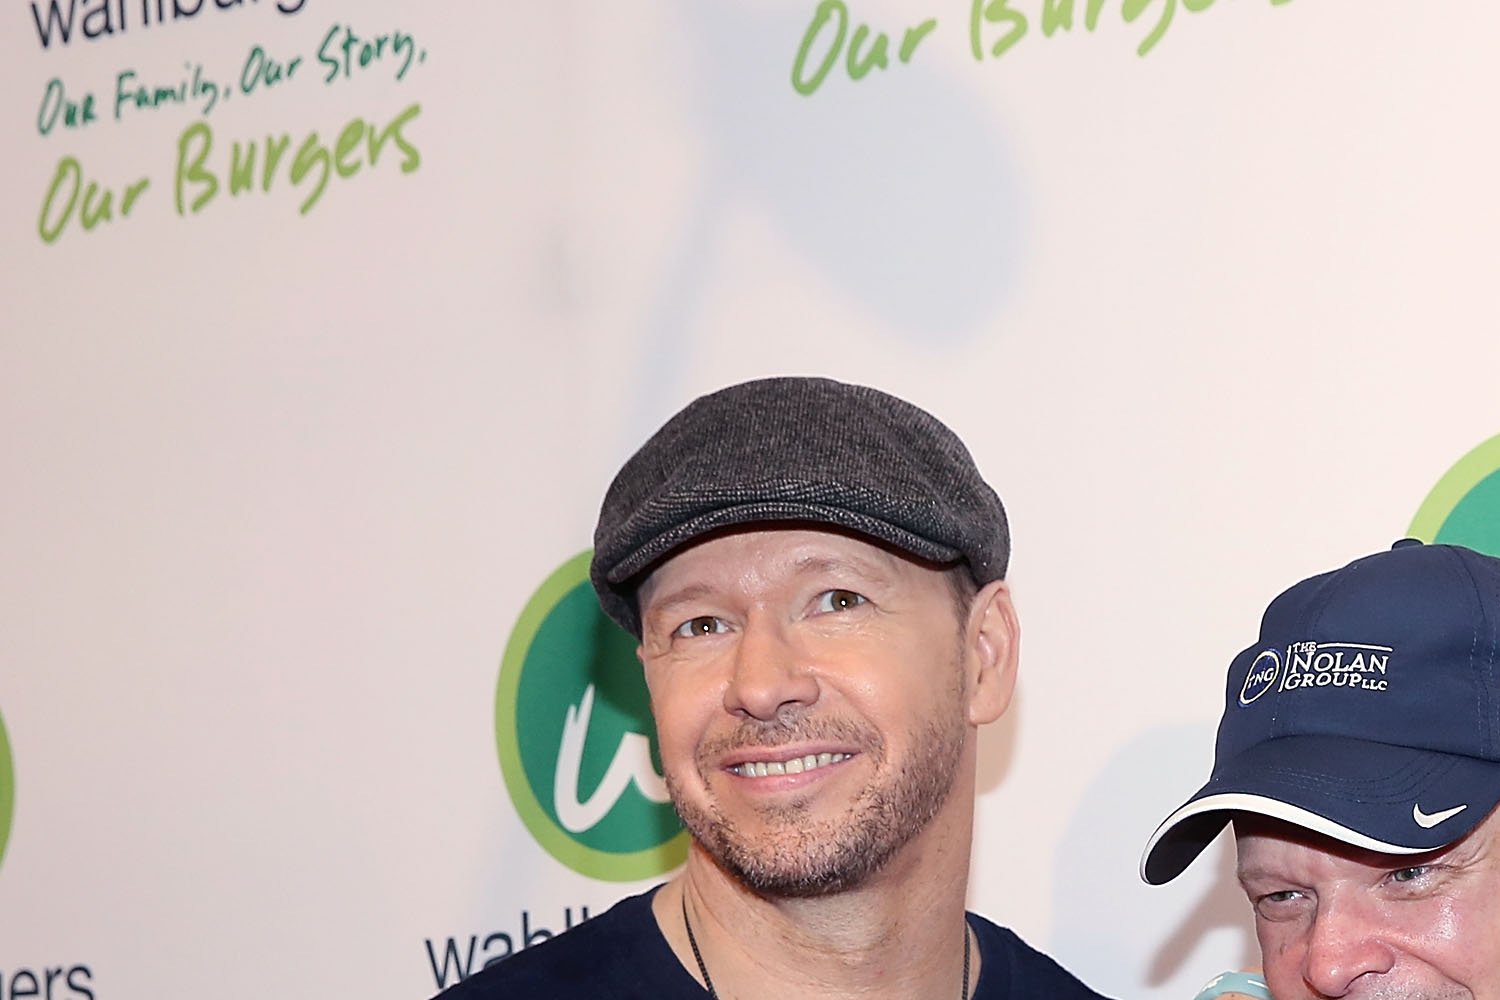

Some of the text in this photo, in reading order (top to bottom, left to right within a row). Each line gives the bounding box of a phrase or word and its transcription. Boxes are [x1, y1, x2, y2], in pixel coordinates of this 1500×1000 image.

[240, 46, 303, 95] Our
[317, 24, 427, 83] Story,
[37, 102, 422, 245] Our Burgers
[1290, 651, 1390, 675] NOLAN
